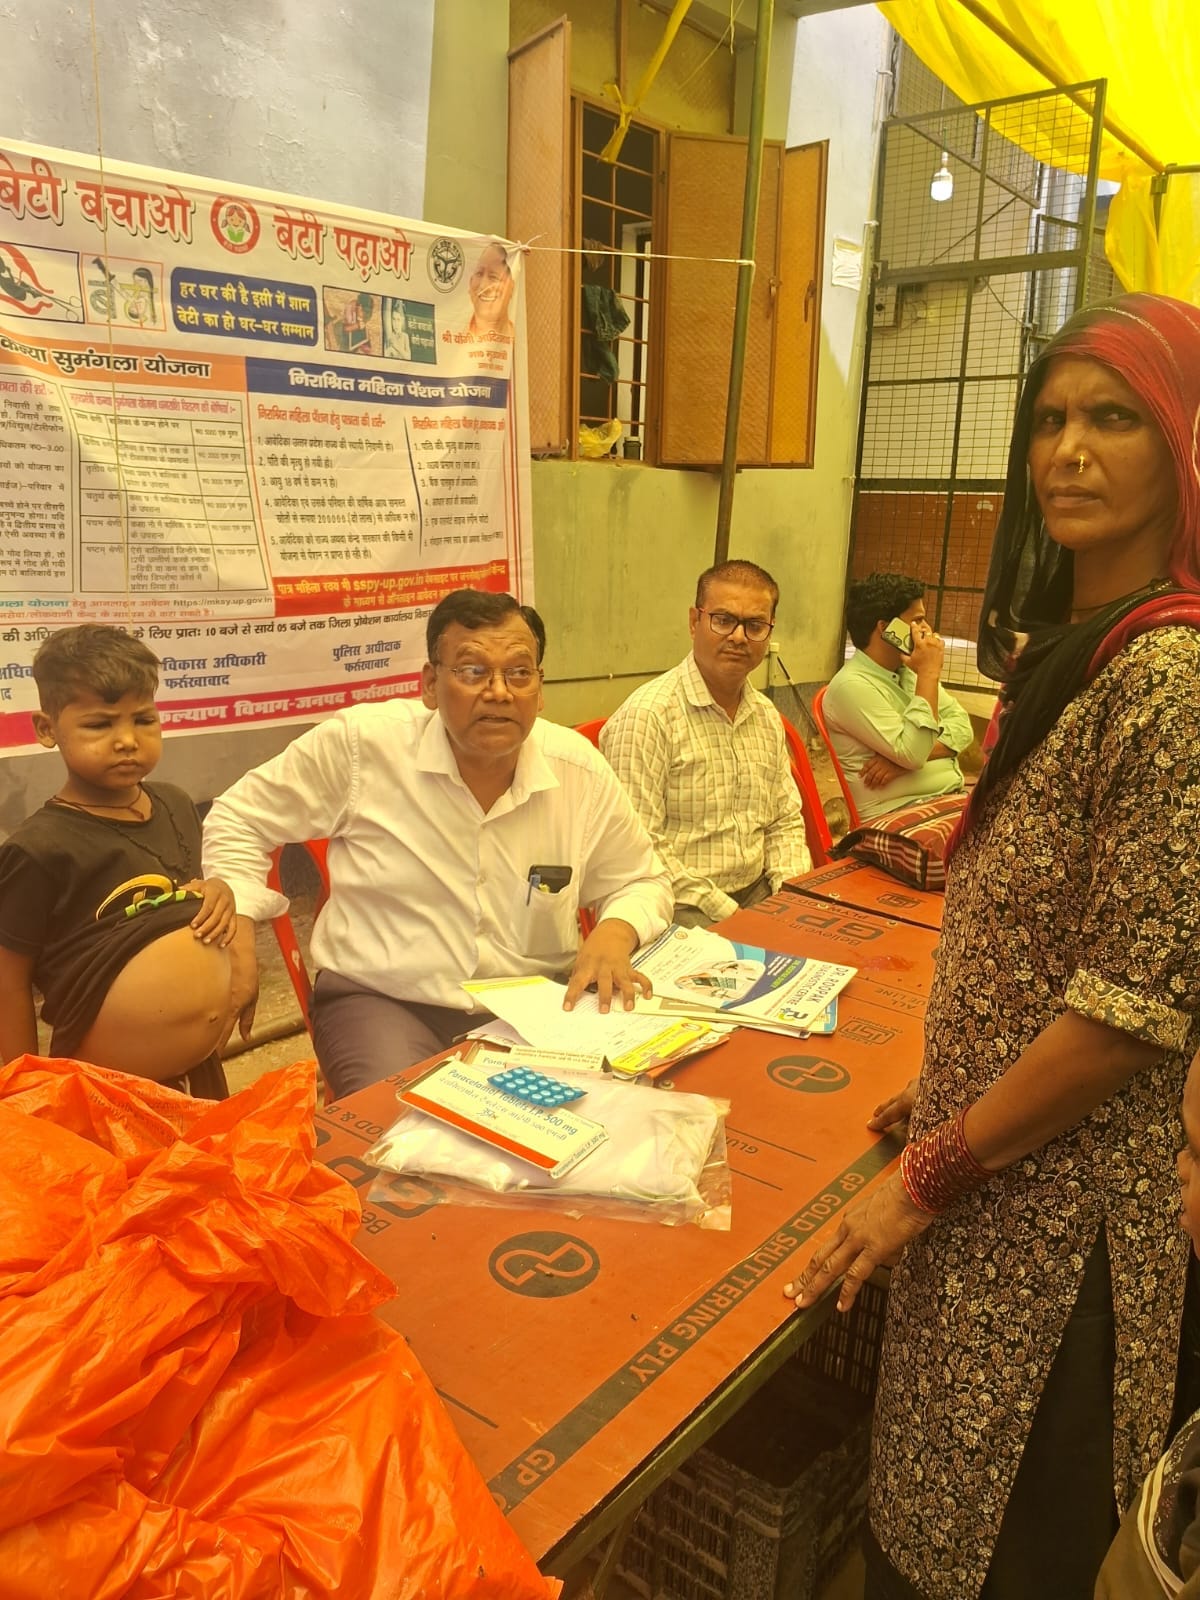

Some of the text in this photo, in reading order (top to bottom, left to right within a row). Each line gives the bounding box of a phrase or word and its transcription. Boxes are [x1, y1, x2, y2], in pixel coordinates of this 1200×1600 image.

[76, 181, 193, 245] बचाओ
[273, 207, 325, 264] बेटी
[333, 228, 412, 282] पढ़ाओ
[179, 281, 310, 312] हर घर की है इसी में शान
[177, 305, 199, 326] बेटी
[202, 313, 219, 328] का
[222, 311, 235, 331] हो
[281, 322, 314, 339] सम्मान
[52, 349, 139, 373] सुमंगला
[143, 354, 211, 377] योजना
[288, 368, 491, 398] निराश्रित महिला पेंशन योजना
[353, 572, 424, 593] sspy-up.gov.in
[2, 628, 20, 642] की
[149, 625, 173, 639] लिए
[176, 627, 201, 639] प्रातः
[206, 627, 216, 637] 10
[219, 623, 238, 636] बजे
[241, 622, 251, 635] से
[254, 621, 274, 633] सायं
[290, 619, 306, 631] बजे
[309, 621, 326, 630] तक
[329, 617, 351, 629] जिला
[353, 615, 382, 628] प्रोबेशन
[162, 651, 267, 671] विकास अधिकारी
[333, 644, 361, 661] पुलिस
[805, 927, 863, 946] Believe
[448, 1069, 499, 1096] Paracetamol
[499, 1092, 528, 1111] Tablets
[544, 1113, 564, 1127] 500
[562, 1123, 578, 1136] mg
[630, 1173, 865, 1383] GP GOLD SHUTTERING PLY
[516, 1449, 556, 1487] GP
